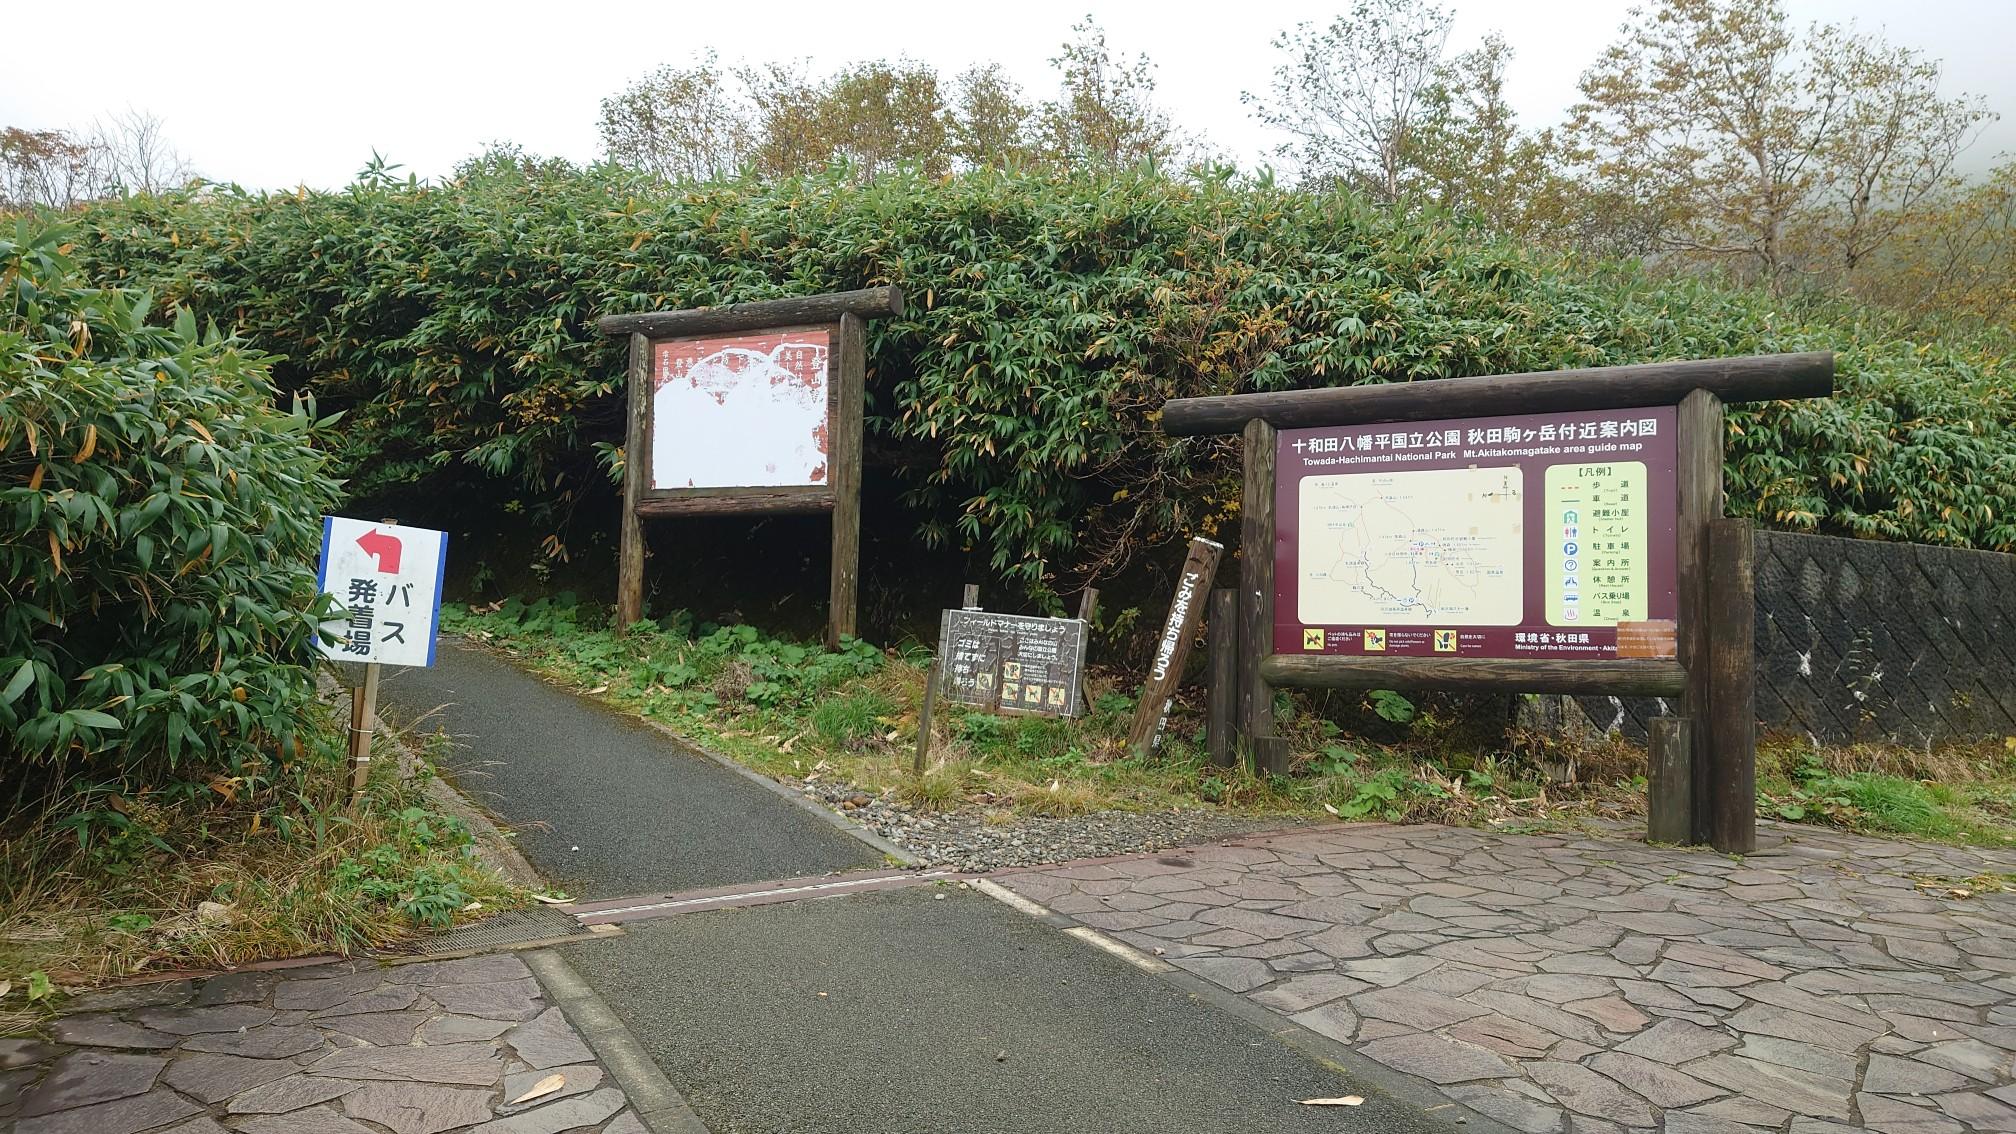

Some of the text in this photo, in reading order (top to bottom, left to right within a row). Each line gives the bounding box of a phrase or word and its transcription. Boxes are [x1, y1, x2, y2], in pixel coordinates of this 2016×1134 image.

[1291, 428, 1461, 454] 十和田八幡平国立公園
[1303, 453, 1393, 467] Towada-Hachimantai
[1395, 451, 1433, 462] National
[1434, 450, 1457, 460] Park
[1463, 444, 1561, 459] Mt.Akitakomagatake
[1588, 441, 1617, 454] guide
[1619, 442, 1643, 452] map
[1593, 525, 1629, 534] トイレ
[1592, 541, 1630, 550] 駐車場
[1592, 558, 1630, 567] 案内所
[1592, 575, 1630, 584] 休憩所
[1592, 591, 1630, 600] バス乗り場
[342, 577, 378, 656] 発着場
[381, 582, 414, 645] バス
[1592, 608, 1630, 617] 温泉
[1515, 632, 1590, 644] 環境省・秋田県
[957, 638, 981, 650] ゴミは
[1515, 643, 1540, 652] Ministry
